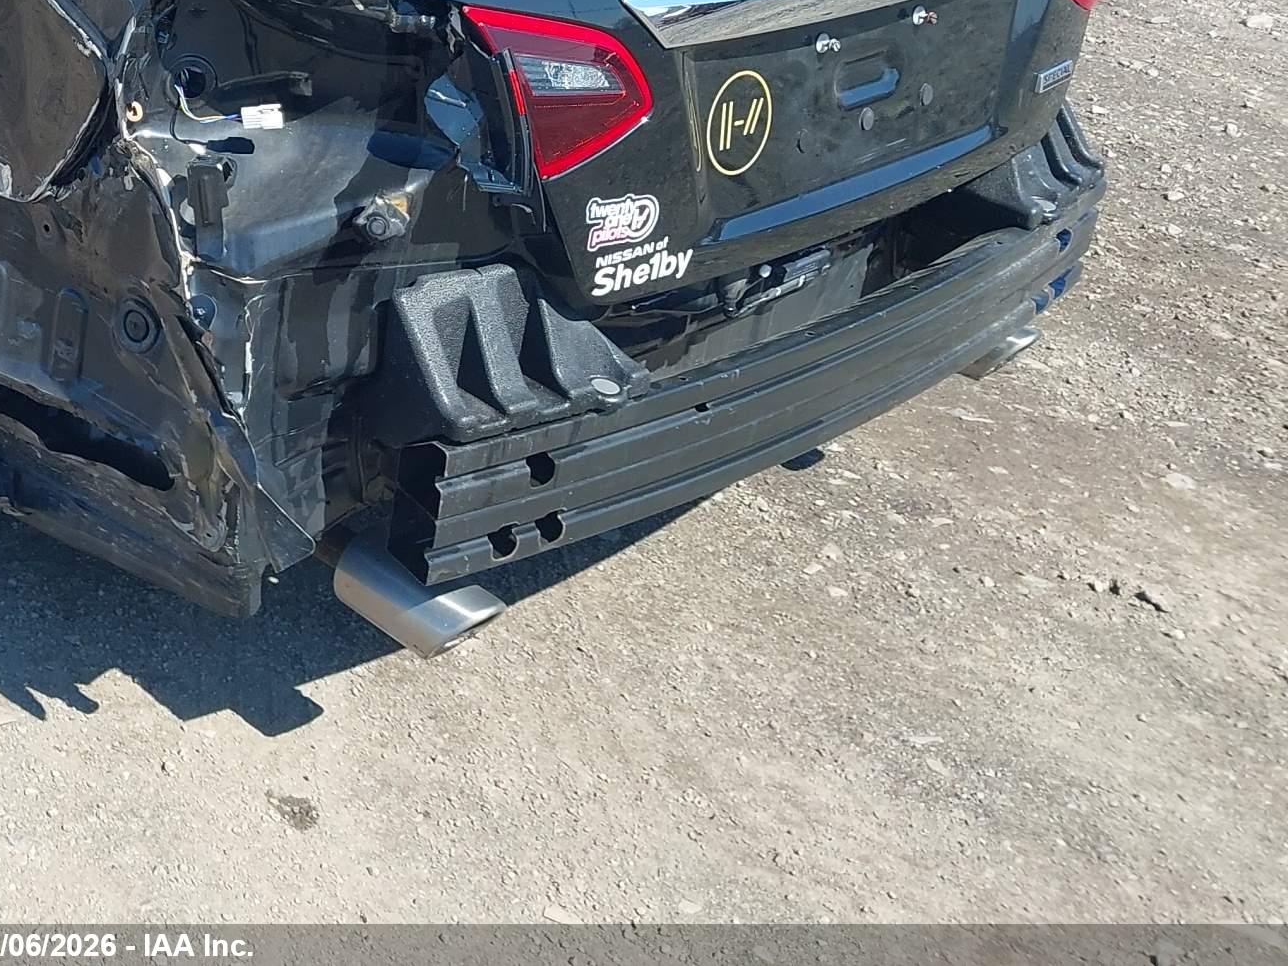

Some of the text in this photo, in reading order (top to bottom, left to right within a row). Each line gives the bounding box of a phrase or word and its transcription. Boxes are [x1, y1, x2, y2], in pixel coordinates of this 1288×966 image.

[590, 198, 633, 219] twenty
[605, 214, 632, 230] one
[592, 224, 630, 247] pilots
[595, 236, 669, 269] NISSAN of
